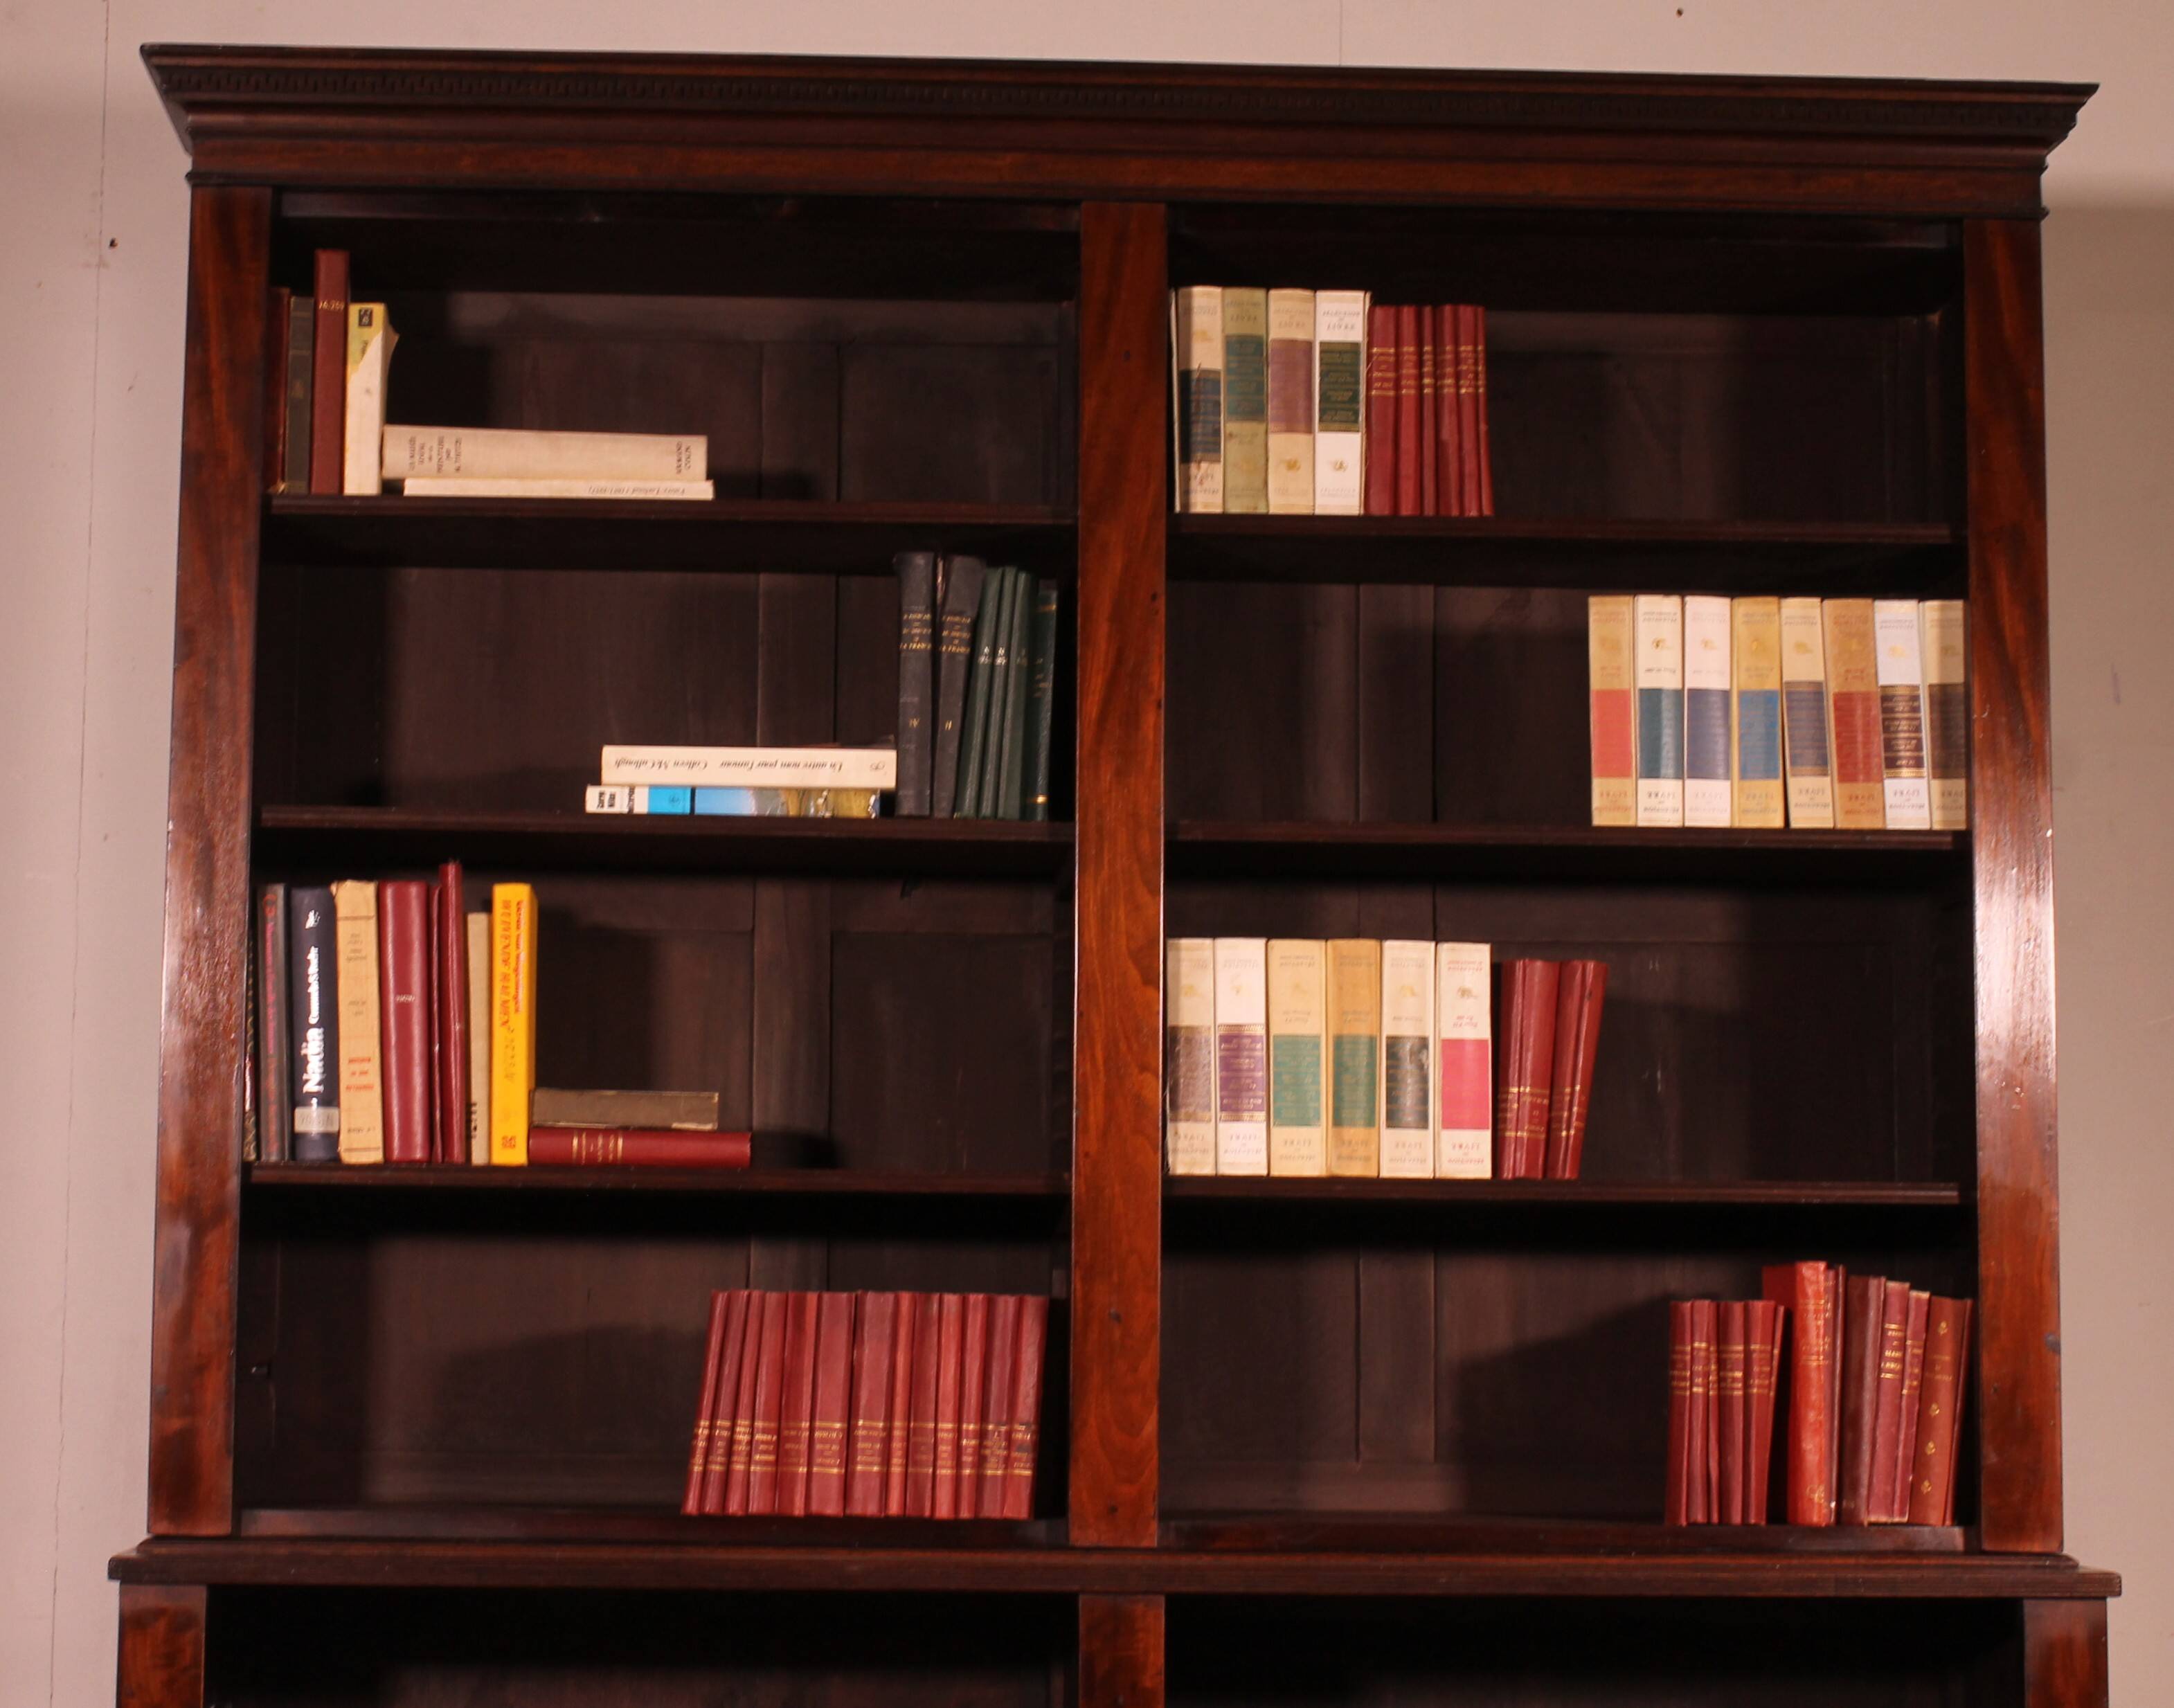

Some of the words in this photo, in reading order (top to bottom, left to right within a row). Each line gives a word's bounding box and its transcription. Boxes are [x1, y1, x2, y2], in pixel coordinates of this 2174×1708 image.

[673, 759, 708, 770] Colleen
[756, 759, 779, 769] pour
[802, 762, 827, 770] autre
[300, 1028, 327, 1094] Nadia
